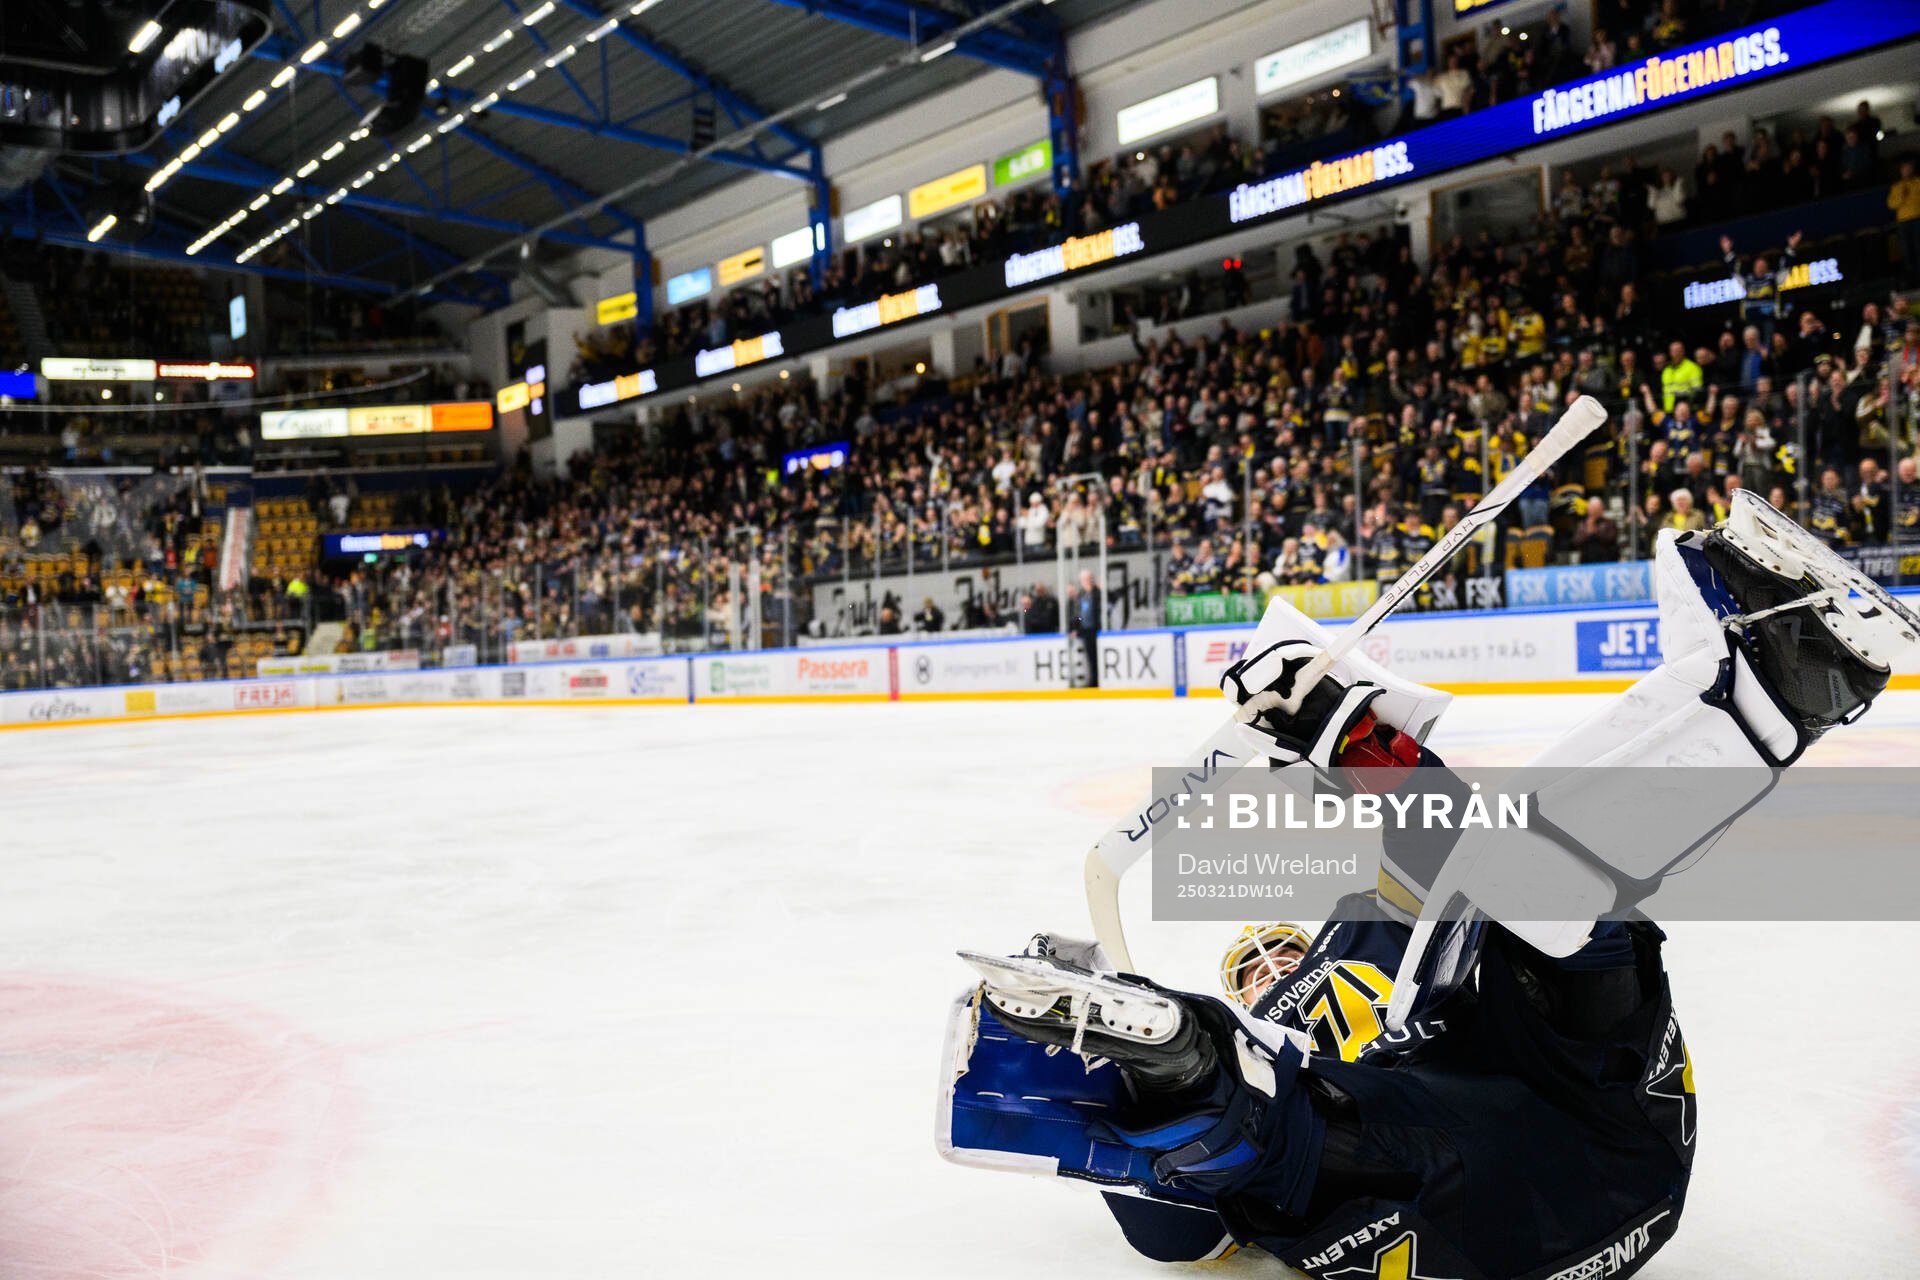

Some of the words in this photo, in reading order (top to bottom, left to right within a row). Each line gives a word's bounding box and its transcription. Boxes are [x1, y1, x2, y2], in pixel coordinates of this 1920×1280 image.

[1466, 577, 1502, 608] FSK
[1511, 575, 1548, 606] FSK
[1557, 571, 1595, 603] FSK
[1605, 568, 1646, 600] FSK
[1395, 645, 1479, 664] GUNNARS
[1489, 638, 1536, 660] TRÅD
[798, 657, 870, 680] Passera
[1264, 960, 1333, 1024] sqvarna
[1302, 1211, 1400, 1270] AXELENT
